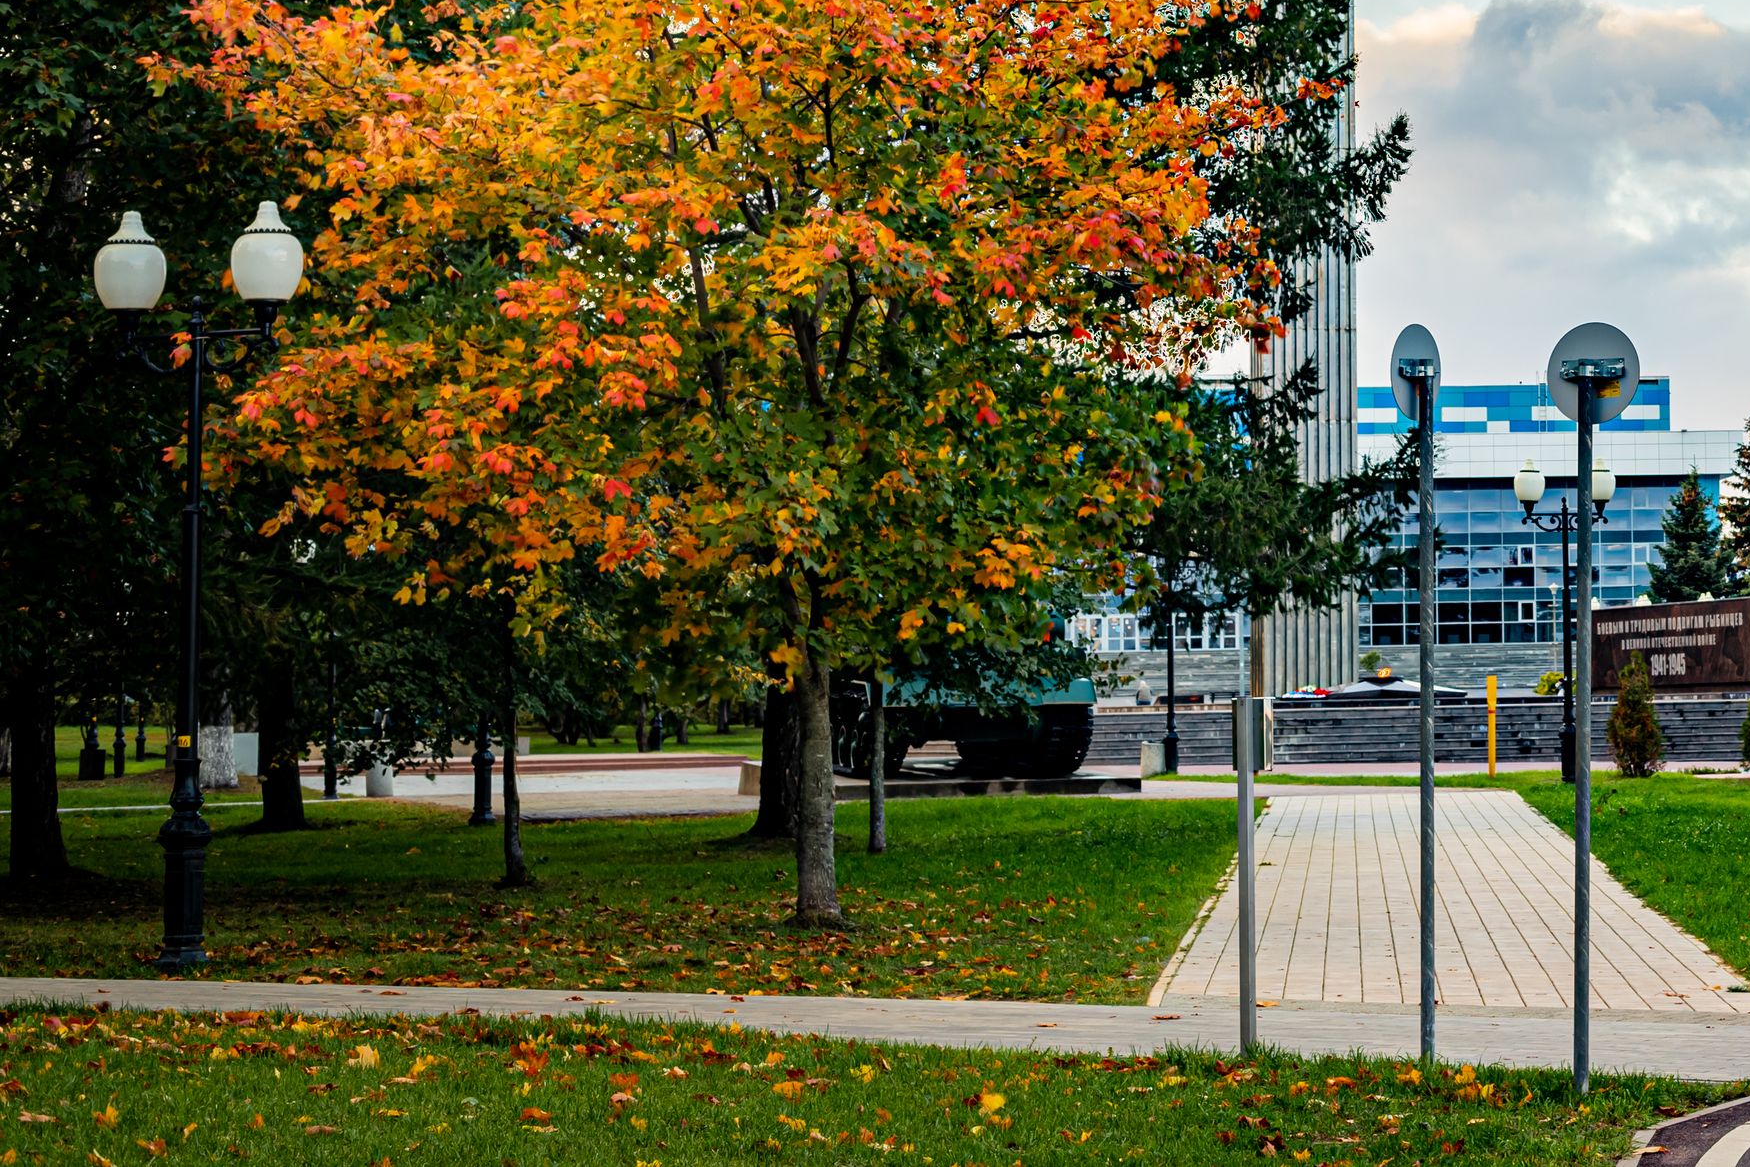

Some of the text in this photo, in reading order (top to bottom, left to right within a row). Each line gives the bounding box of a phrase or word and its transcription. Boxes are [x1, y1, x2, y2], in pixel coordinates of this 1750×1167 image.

[1597, 612, 1743, 635] БОЕВЫМ И ТРУДОВЫМ ПОДВИГАМ РЫБИНЦЕВ
[1621, 633, 1716, 650] В ВЕЛИКОЙ ОТЕЧЕСТВЕННОЙ ВОЙНЕ
[1651, 652, 1686, 676] 1941-1945
